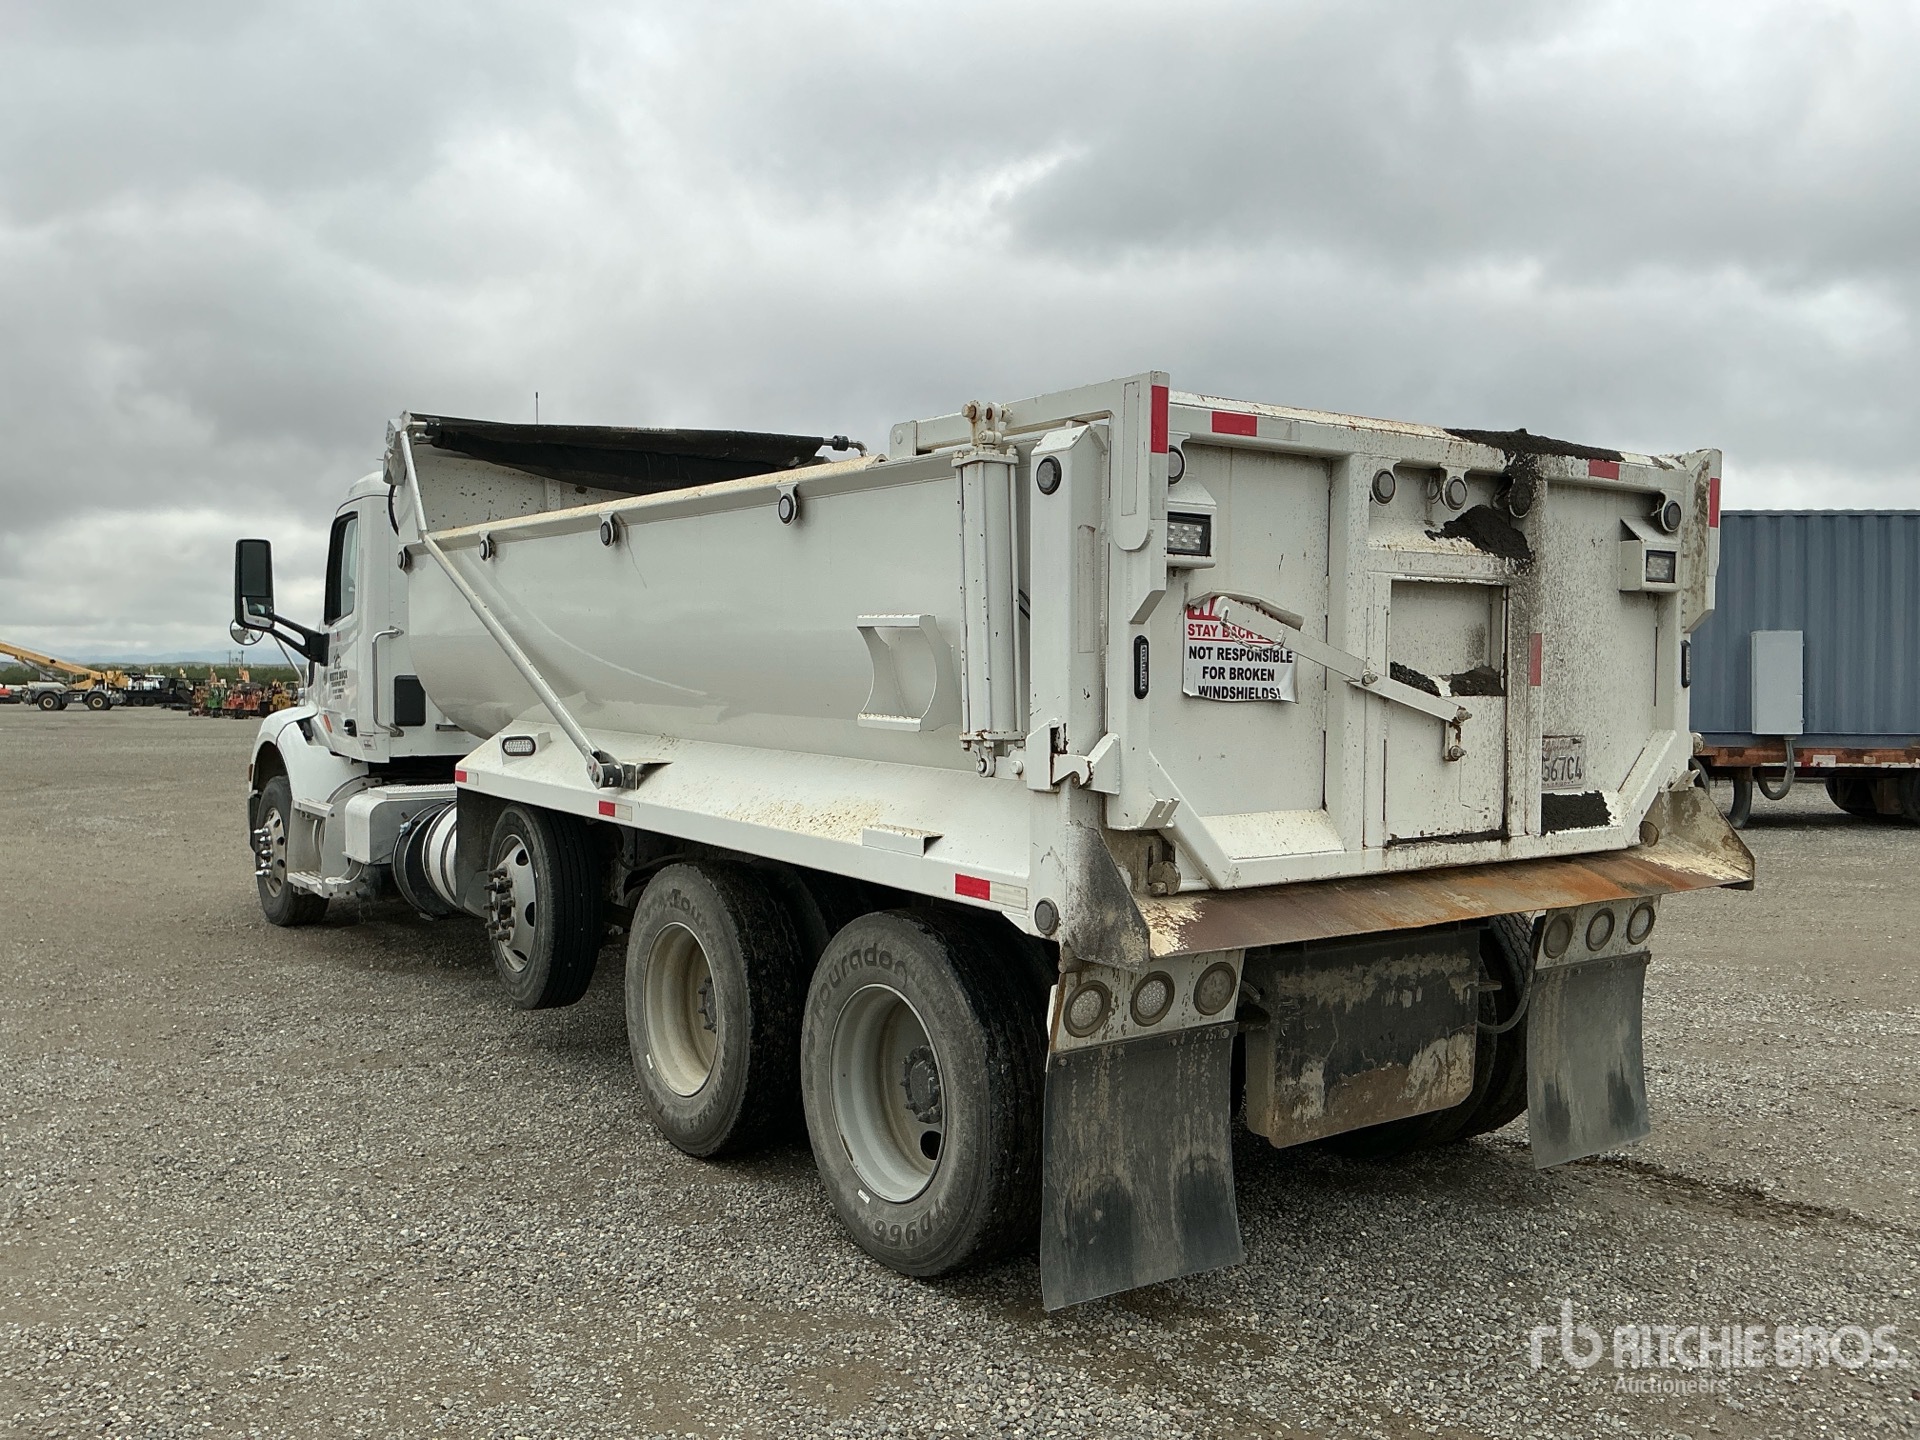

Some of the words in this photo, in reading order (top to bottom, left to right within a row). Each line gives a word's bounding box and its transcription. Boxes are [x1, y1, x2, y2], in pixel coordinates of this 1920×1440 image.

[1187, 623, 1219, 637] STAY
[1188, 645, 1214, 660] NOT
[1217, 647, 1293, 663] RESPONSIBLE
[1202, 666, 1226, 680] FOR
[1229, 667, 1275, 681] BROKEN
[1198, 685, 1282, 700] WINDSHIELDS!
